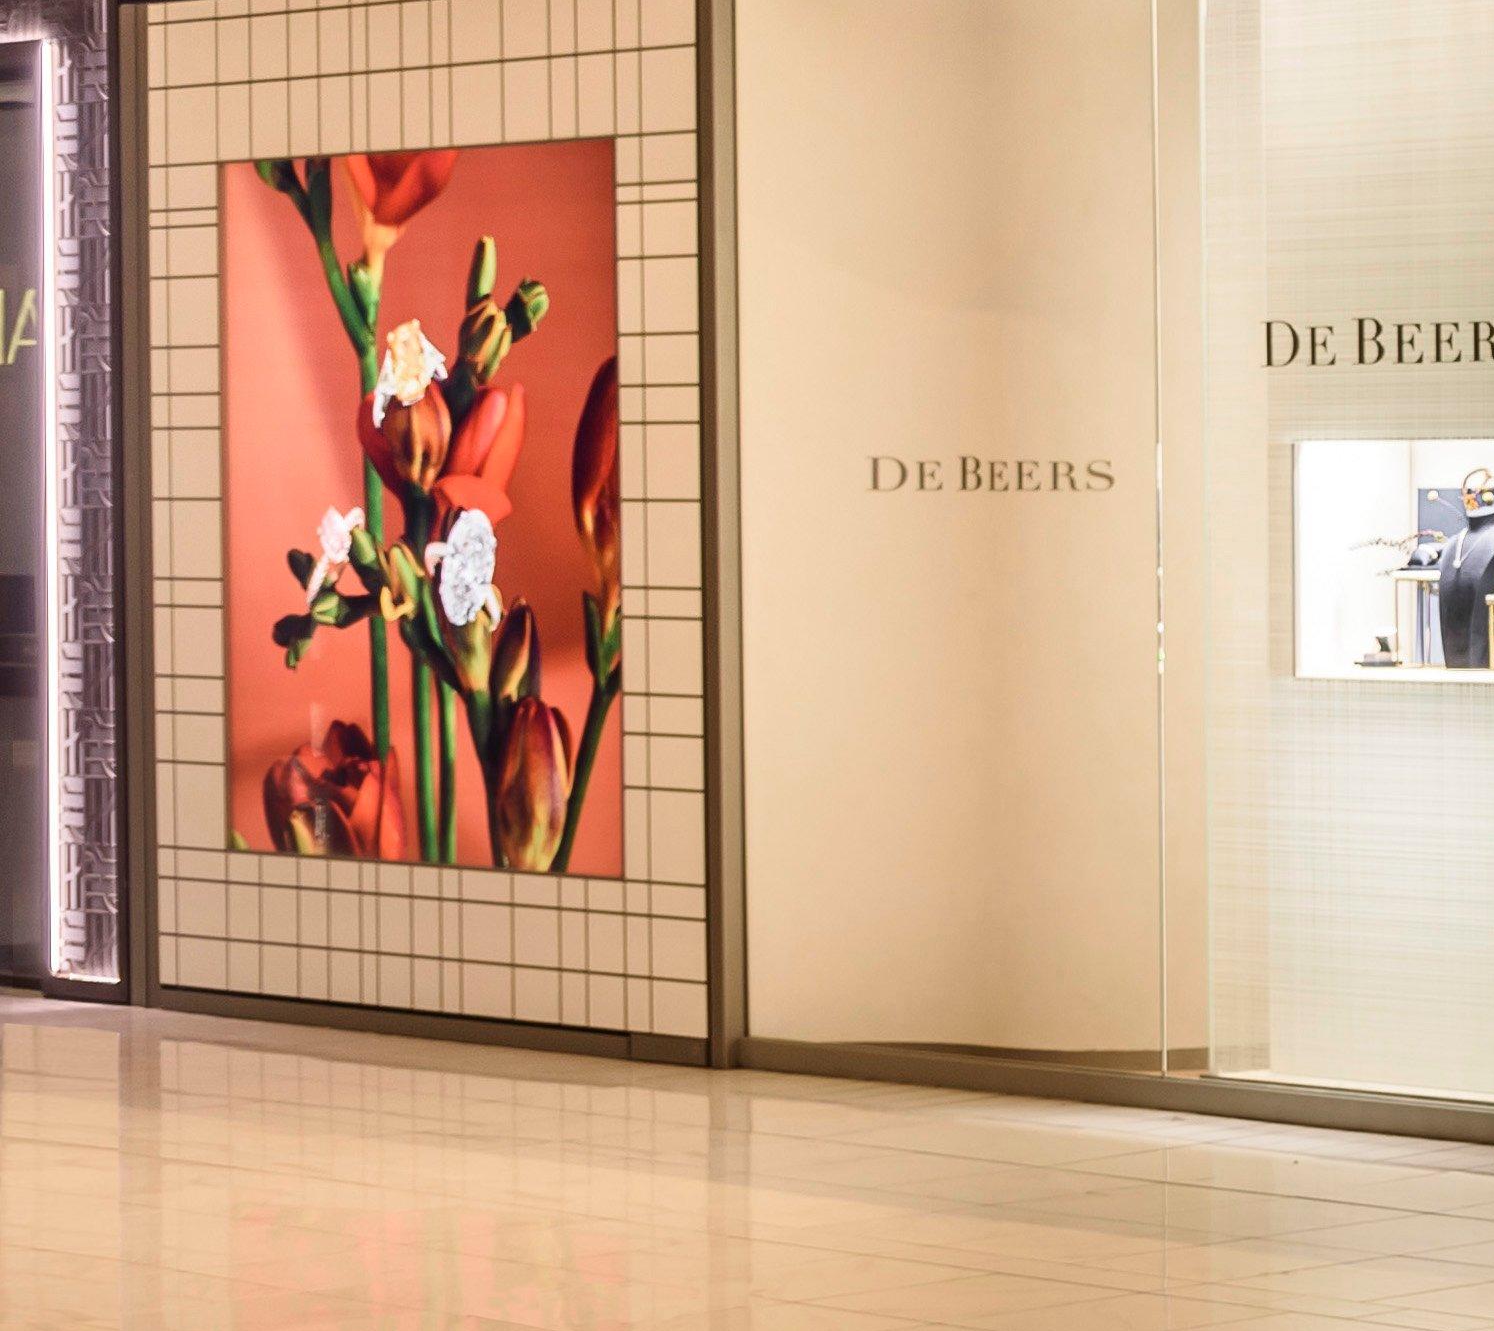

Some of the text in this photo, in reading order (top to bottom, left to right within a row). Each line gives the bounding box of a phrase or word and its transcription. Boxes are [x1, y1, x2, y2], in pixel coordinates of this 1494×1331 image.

[1262, 319, 1338, 367] DE
[866, 455, 1116, 492] DE BEERS
